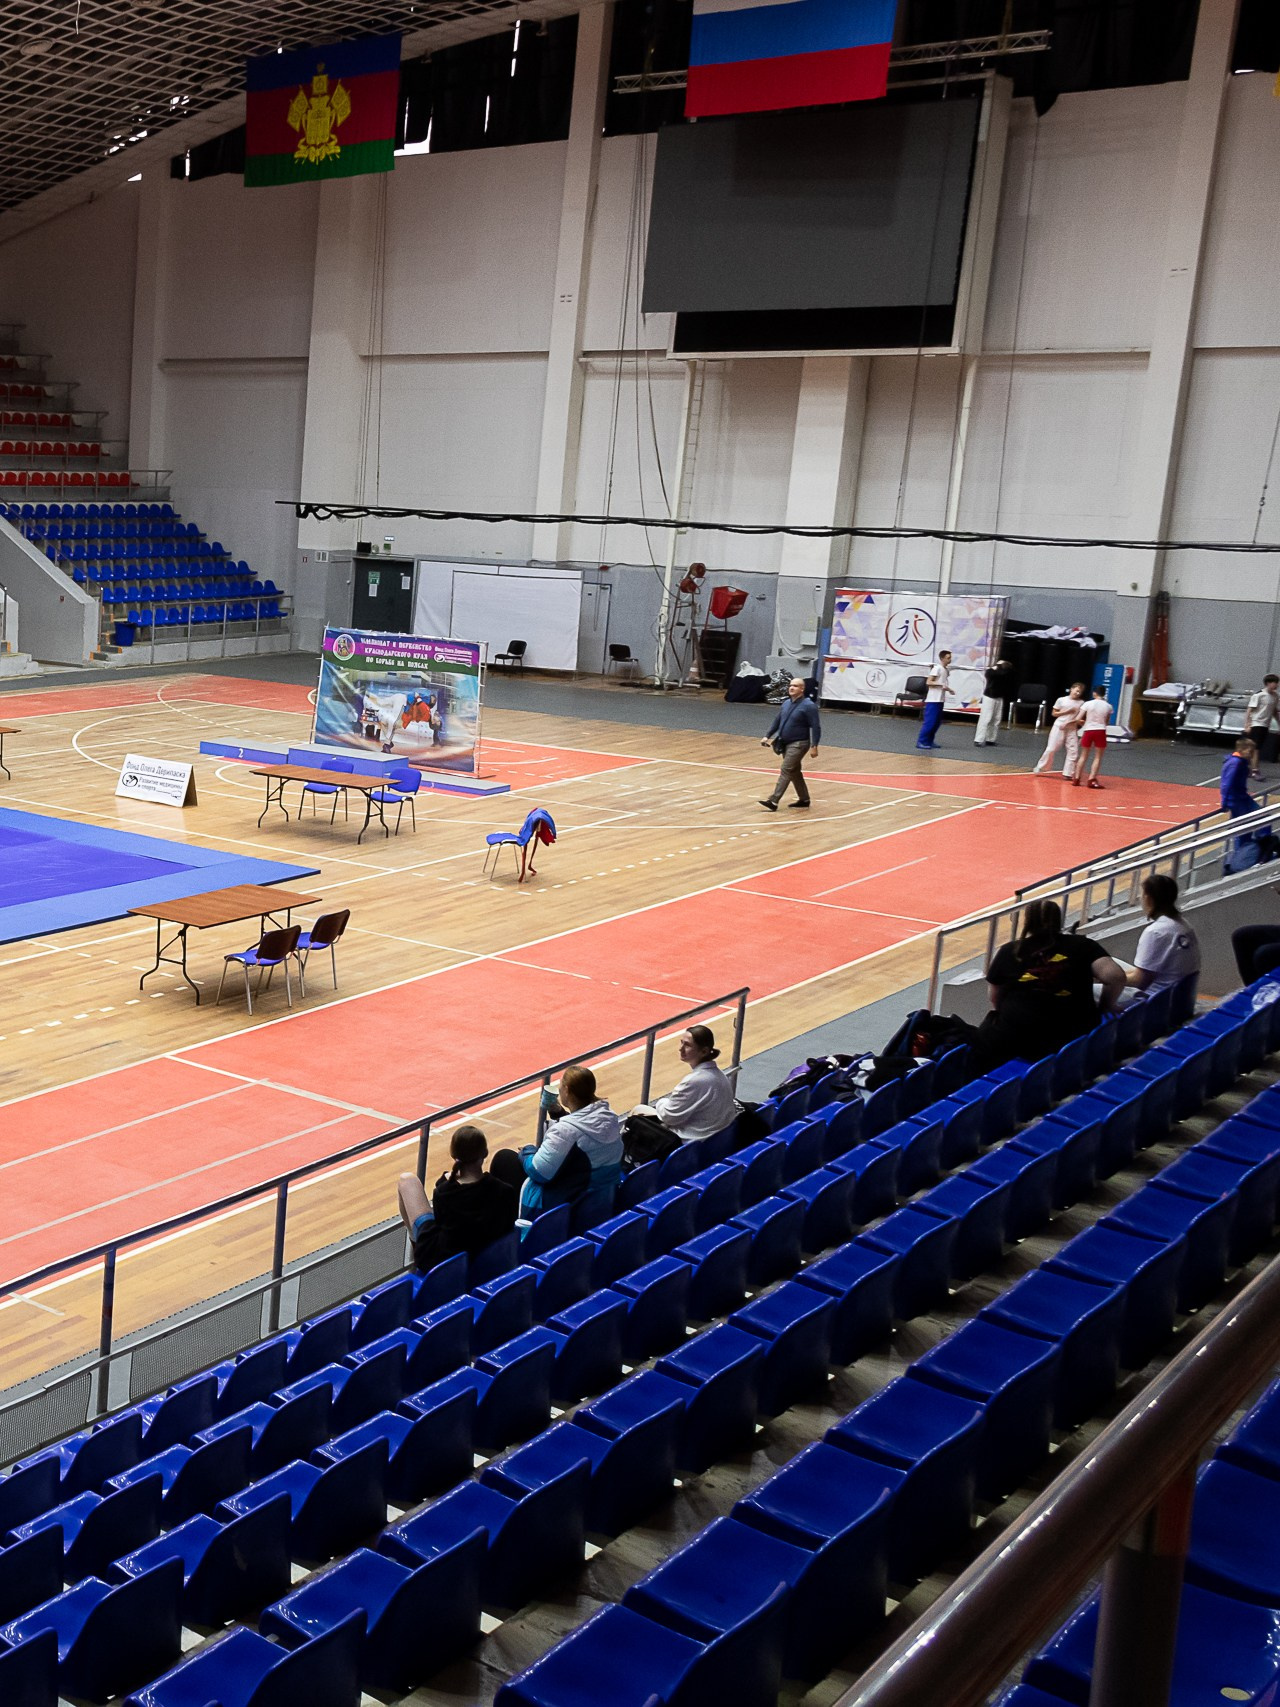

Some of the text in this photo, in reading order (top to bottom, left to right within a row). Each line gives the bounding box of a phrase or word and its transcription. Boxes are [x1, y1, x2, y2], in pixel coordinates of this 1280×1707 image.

[126, 761, 185, 778] Фонд Олега Дерипаска
